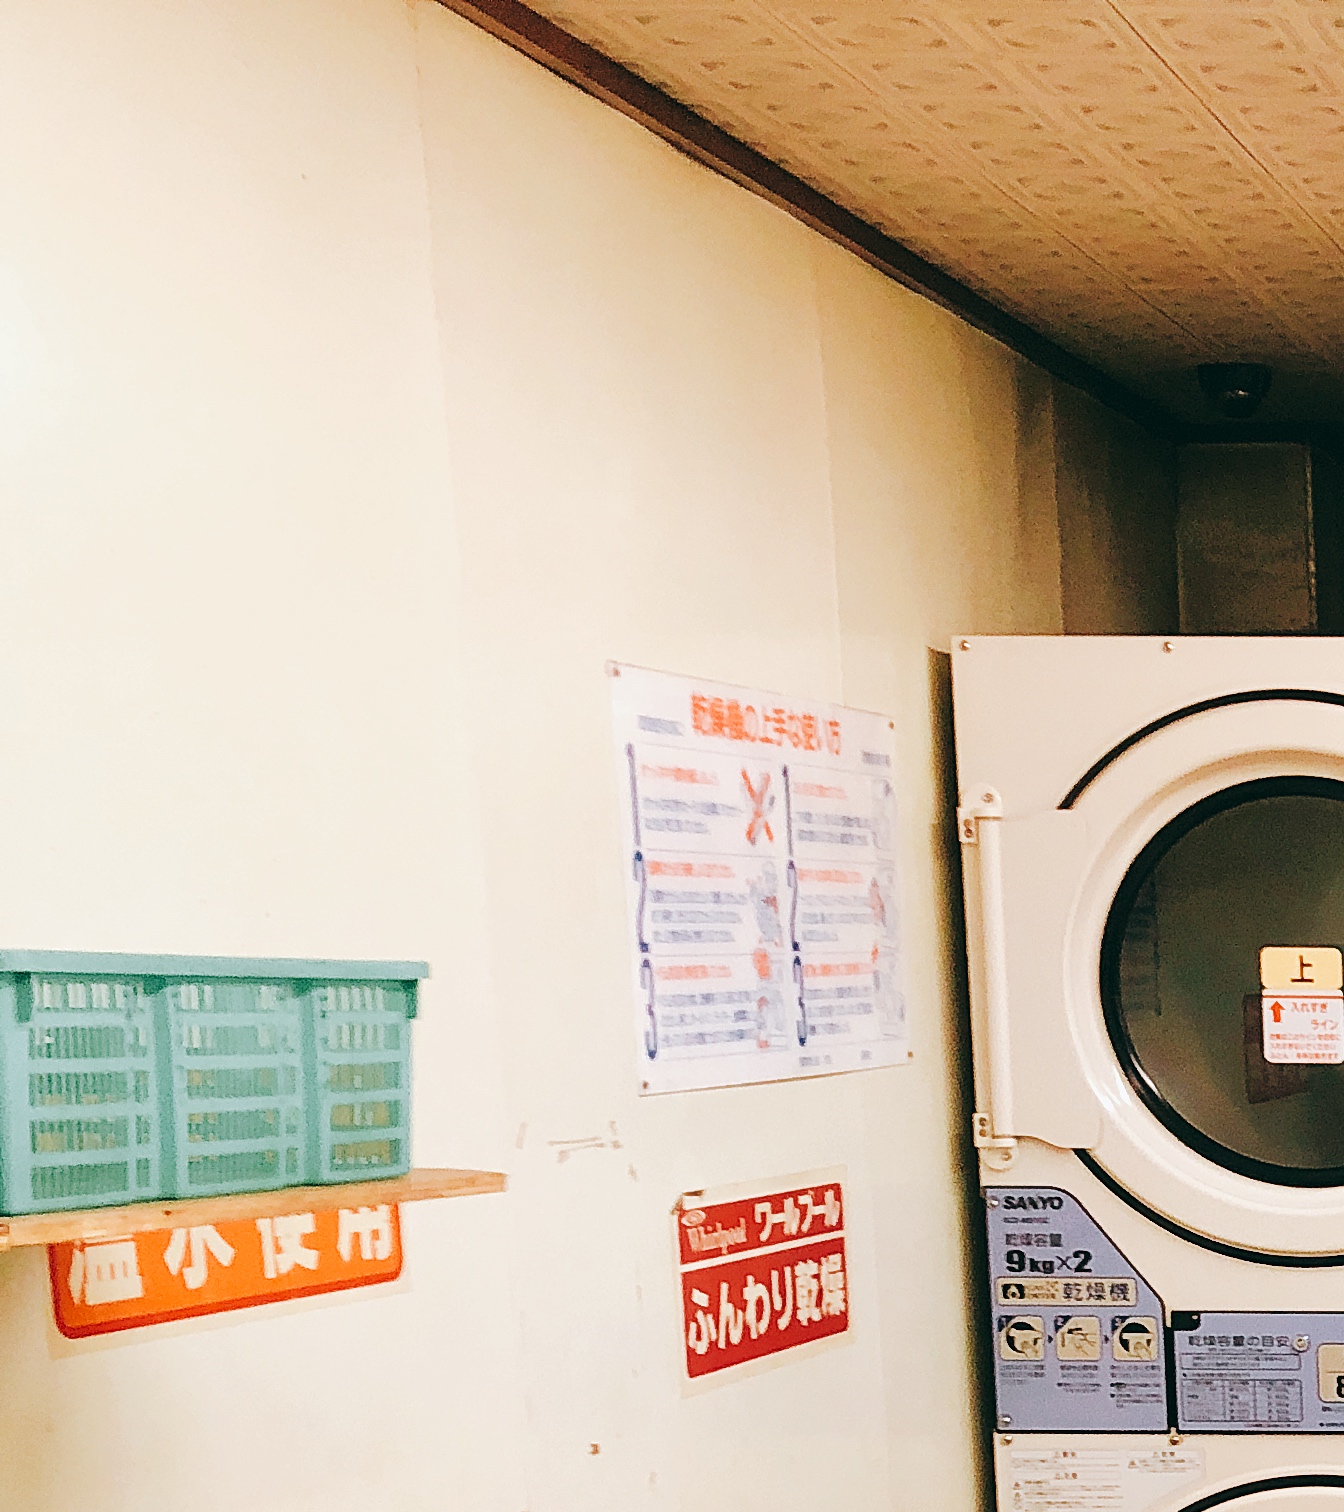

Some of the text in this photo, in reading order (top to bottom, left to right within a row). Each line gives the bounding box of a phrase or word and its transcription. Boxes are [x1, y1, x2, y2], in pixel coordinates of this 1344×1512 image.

[1290, 954, 1315, 983] 上
[1290, 1001, 1329, 1014] 入れすぎ
[1310, 1019, 1339, 1031] ライン
[1002, 1195, 1065, 1211] SANYO
[1062, 1282, 1131, 1302] 乾燥機
[688, 1252, 846, 1356] ふんわり乾燥
